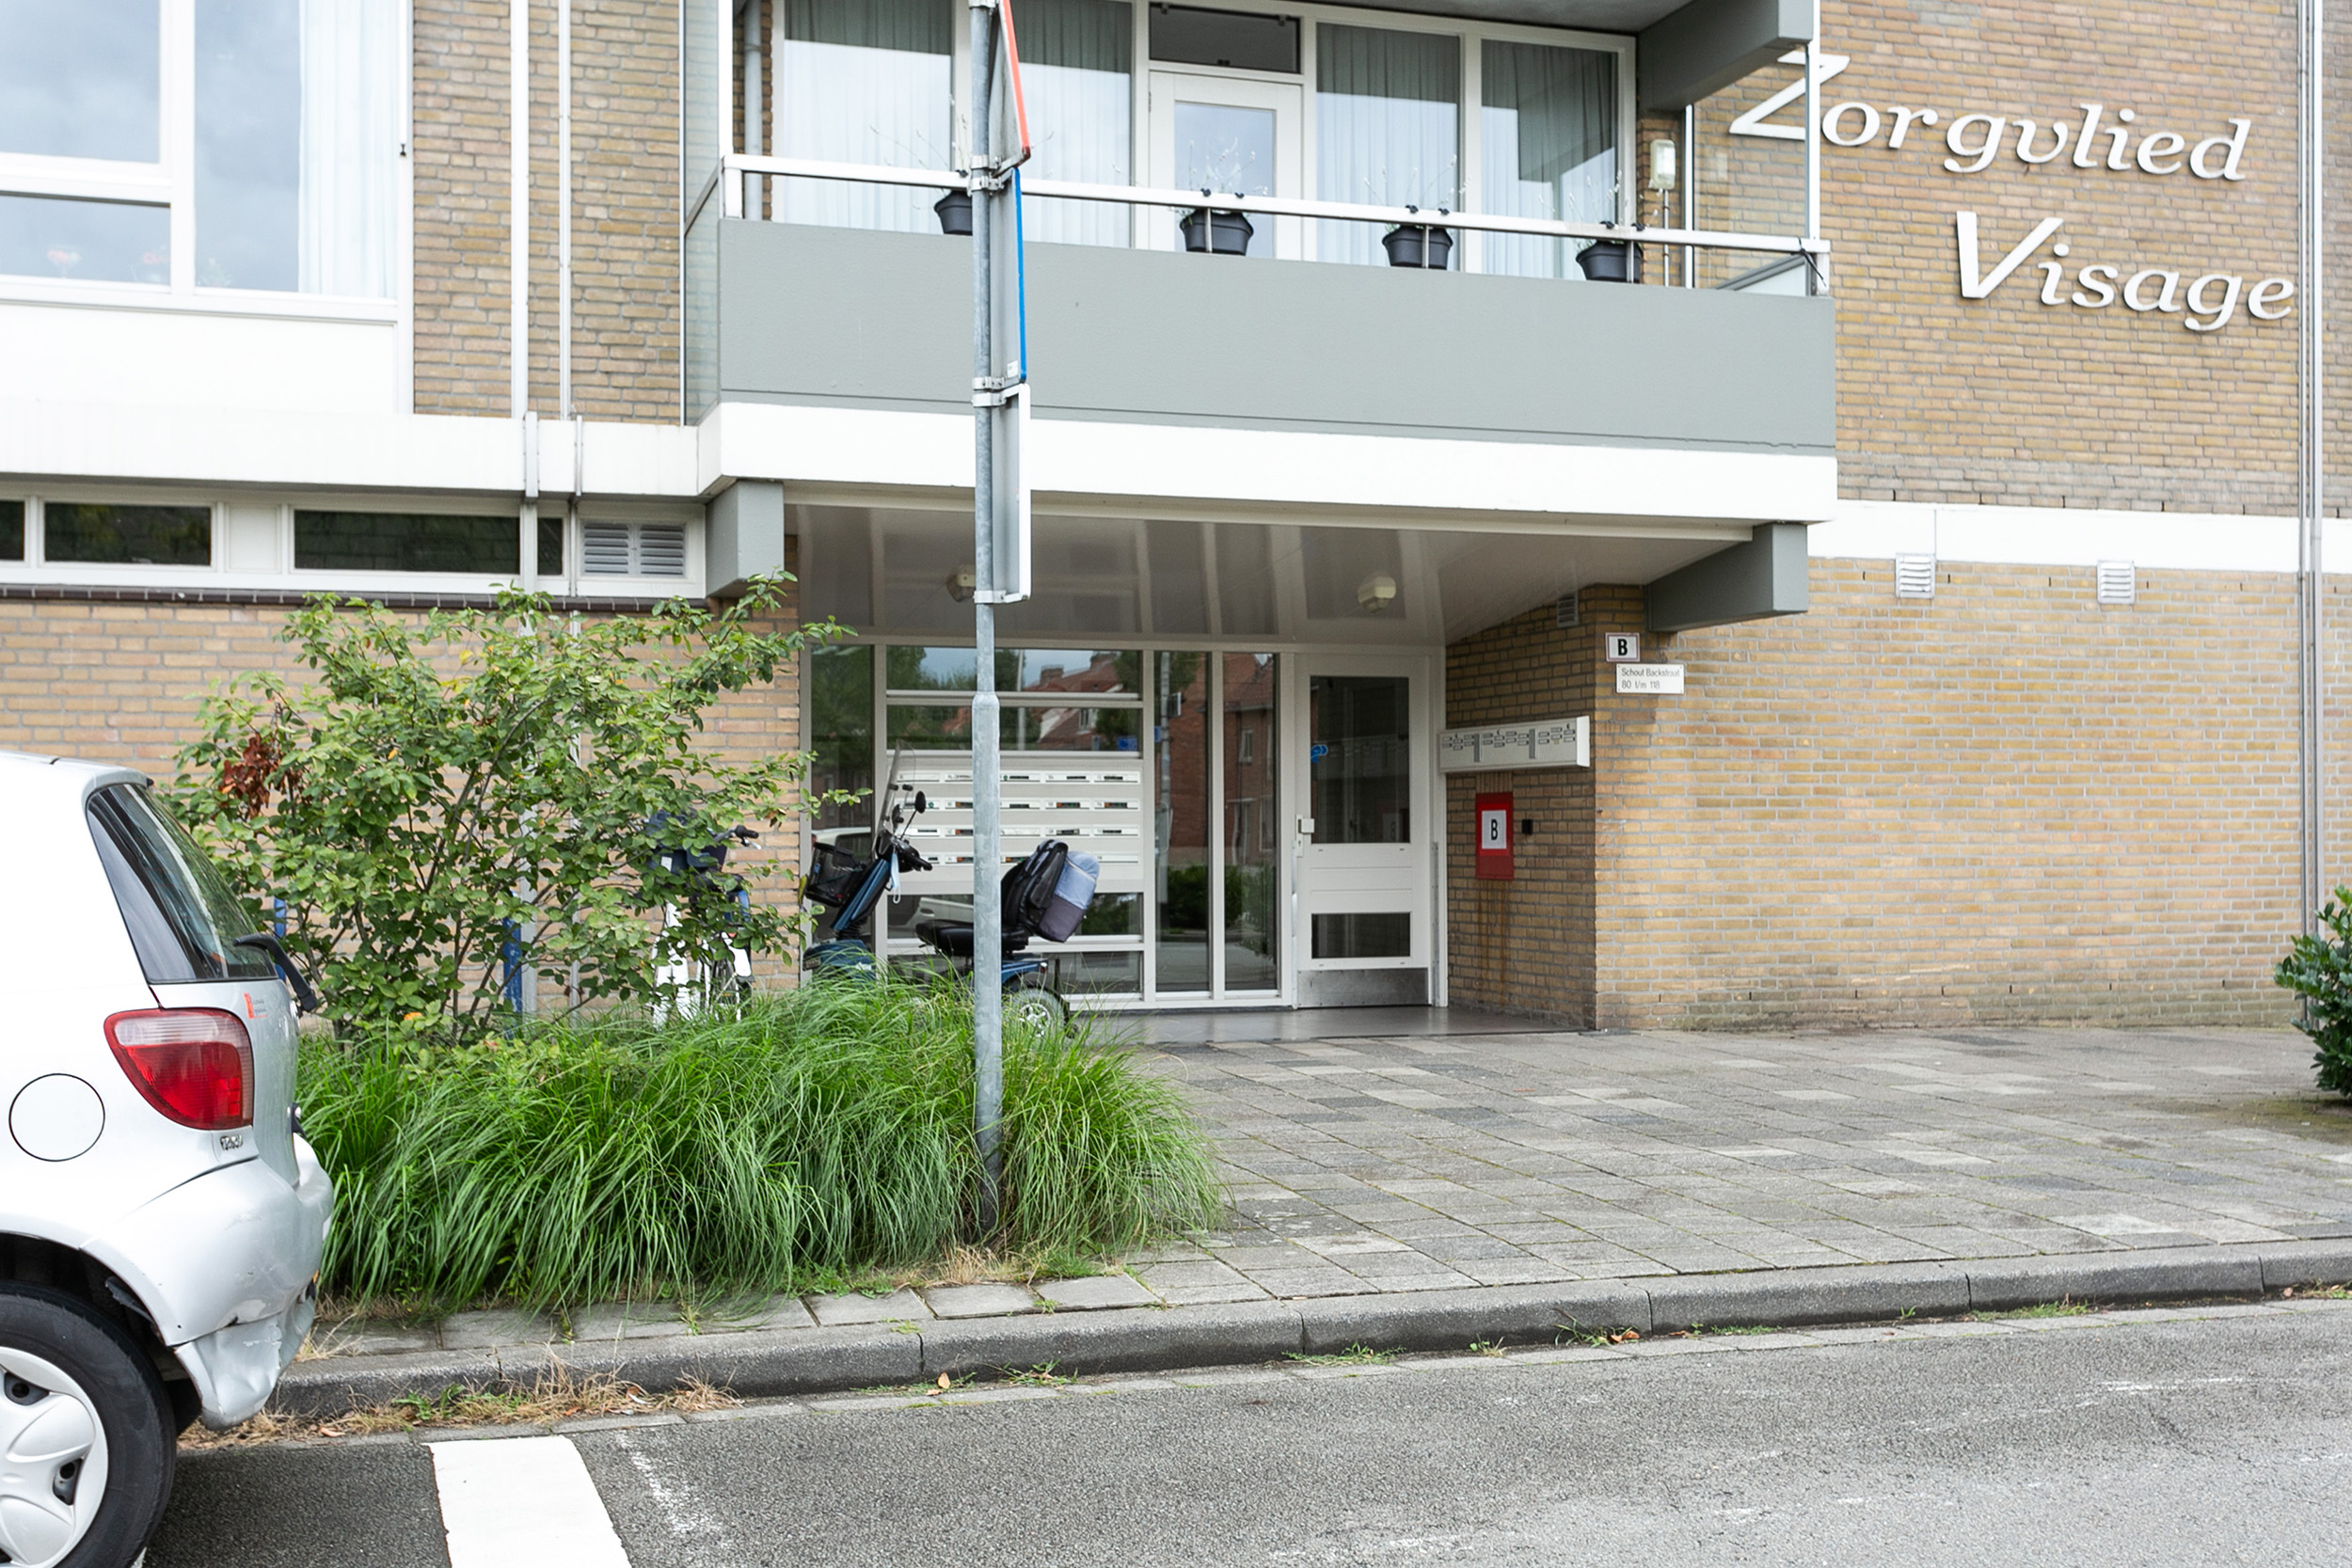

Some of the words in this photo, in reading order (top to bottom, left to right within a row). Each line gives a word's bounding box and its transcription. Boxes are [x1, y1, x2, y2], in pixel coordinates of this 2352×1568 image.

[1729, 51, 2251, 182] Zorgvlied
[1956, 210, 2296, 332] Visage
[1617, 638, 1629, 657] B
[1621, 667, 1645, 677] Schout
[1621, 679, 1632, 689] 80
[1634, 679, 1647, 689] t/m
[1490, 818, 1499, 841] B
